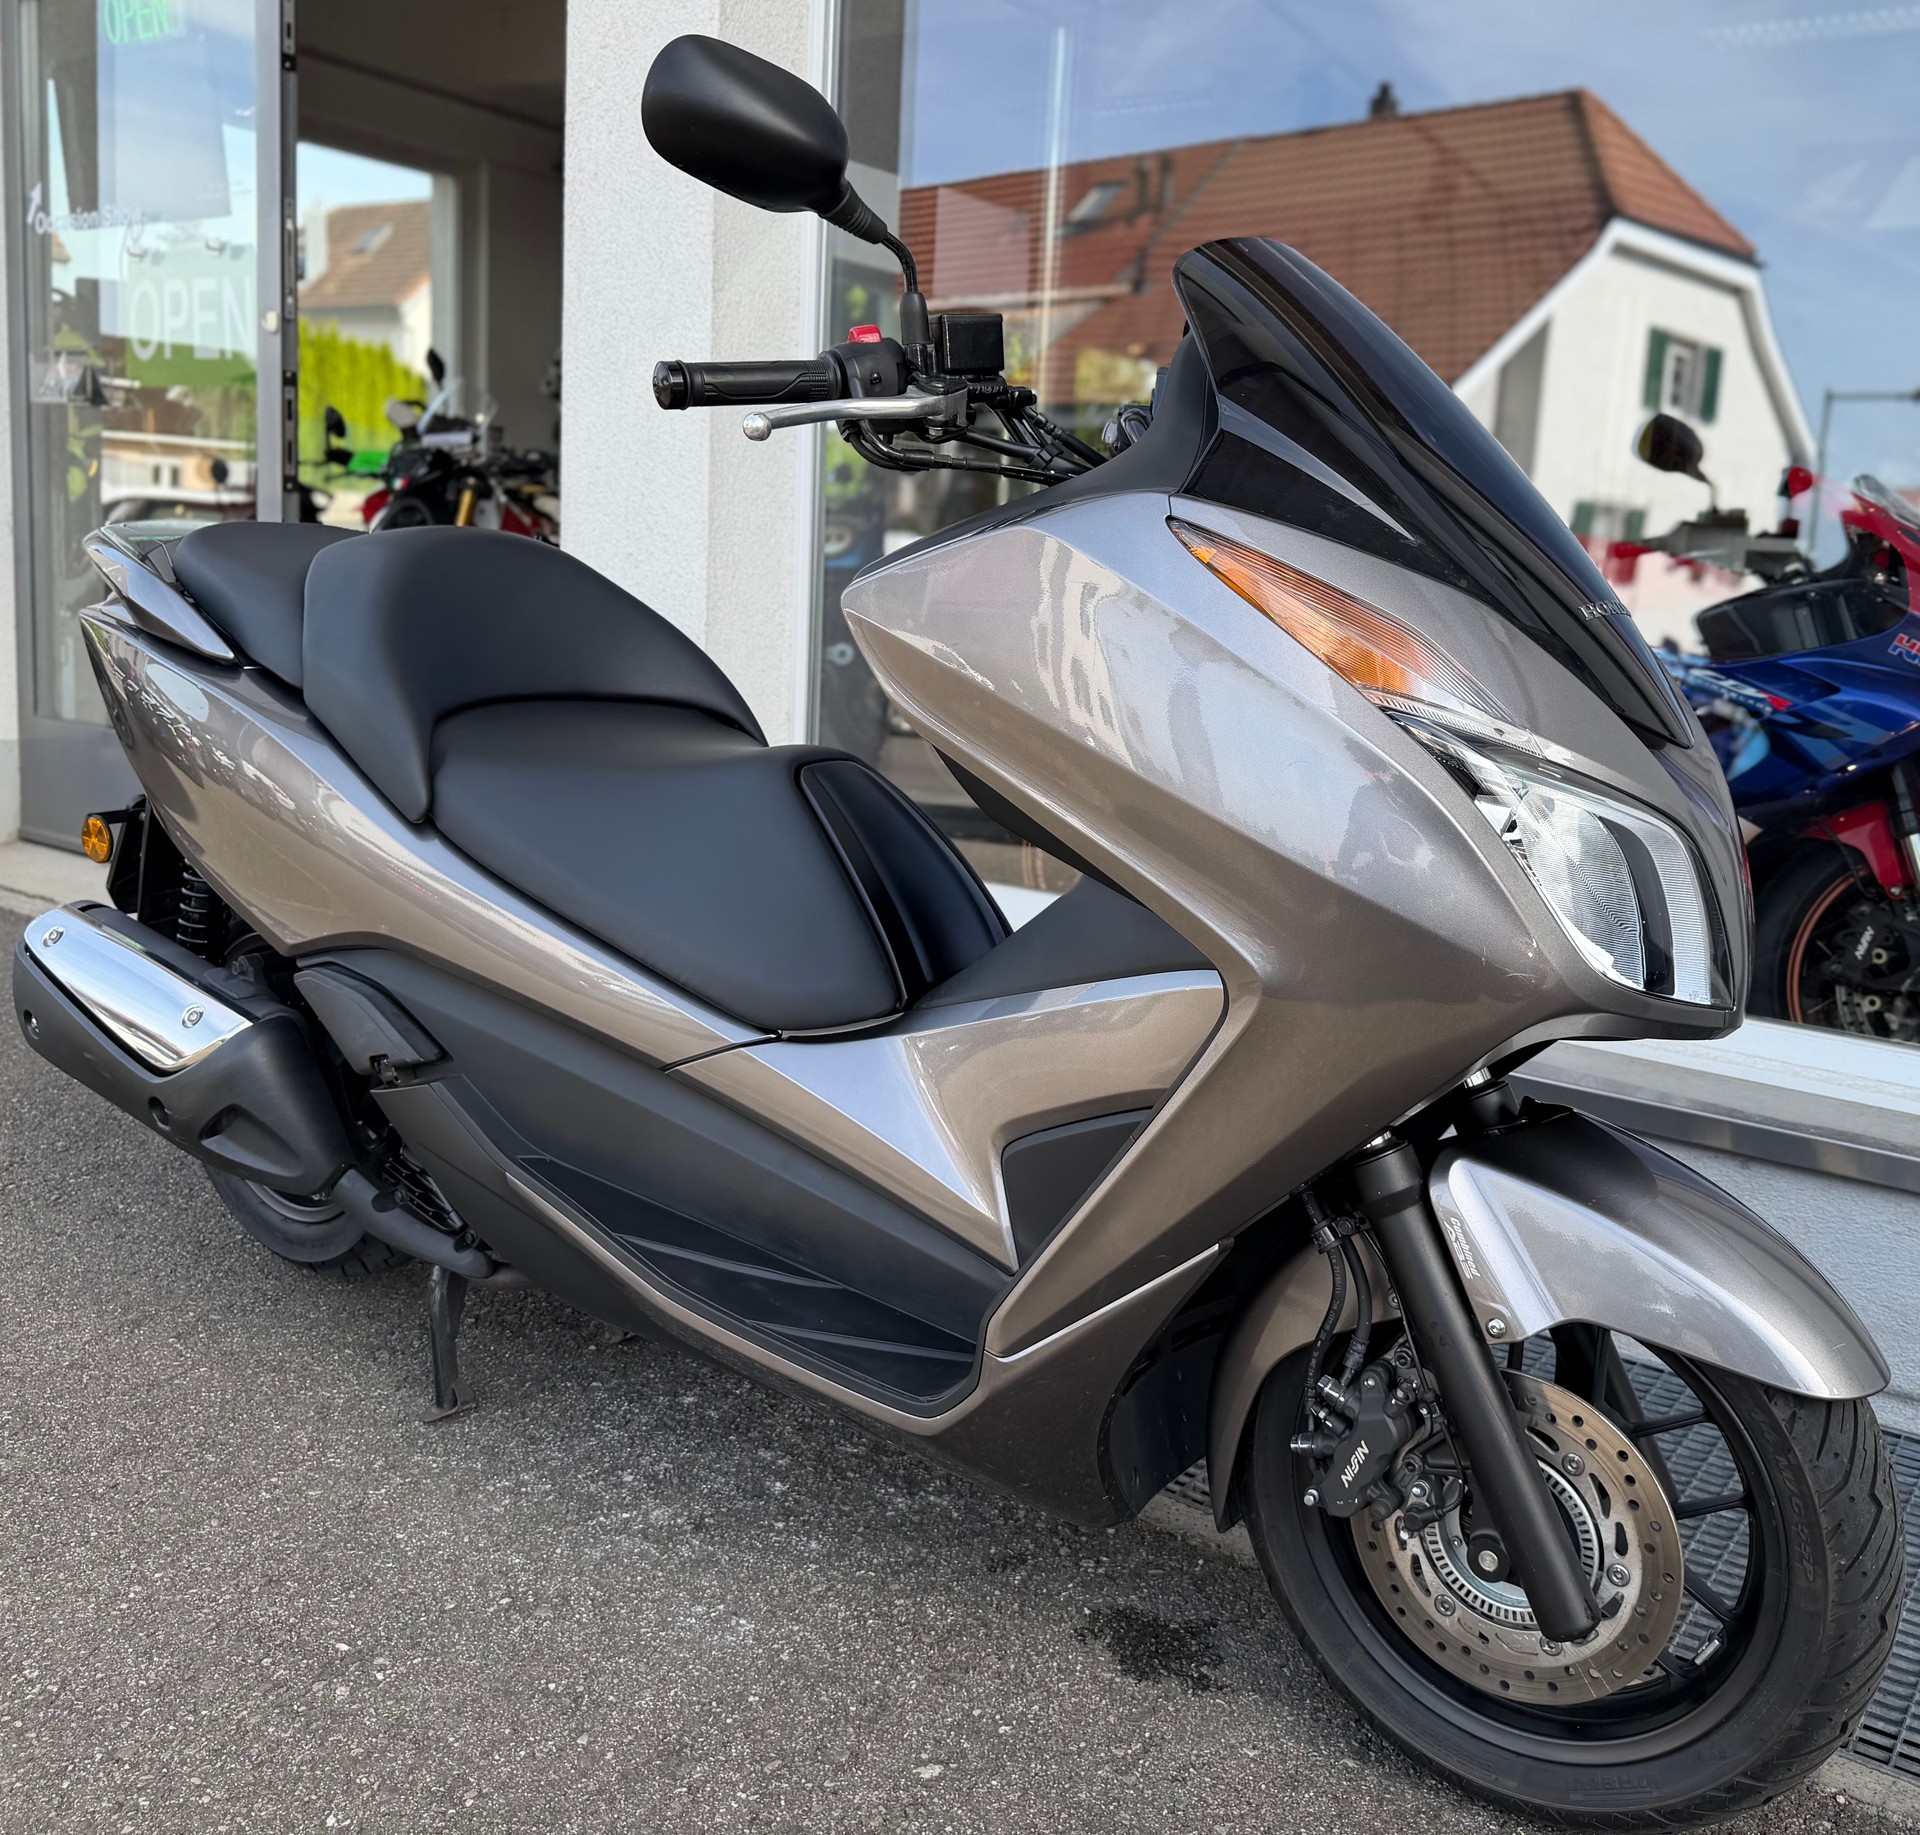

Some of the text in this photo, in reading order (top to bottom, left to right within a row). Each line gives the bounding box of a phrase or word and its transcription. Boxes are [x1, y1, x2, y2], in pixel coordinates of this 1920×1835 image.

[104, 0, 170, 44] OPEN
[130, 277, 256, 361] OPEN
[1443, 1220, 1474, 1280] ABS
[1450, 1217, 1481, 1277] Combined
